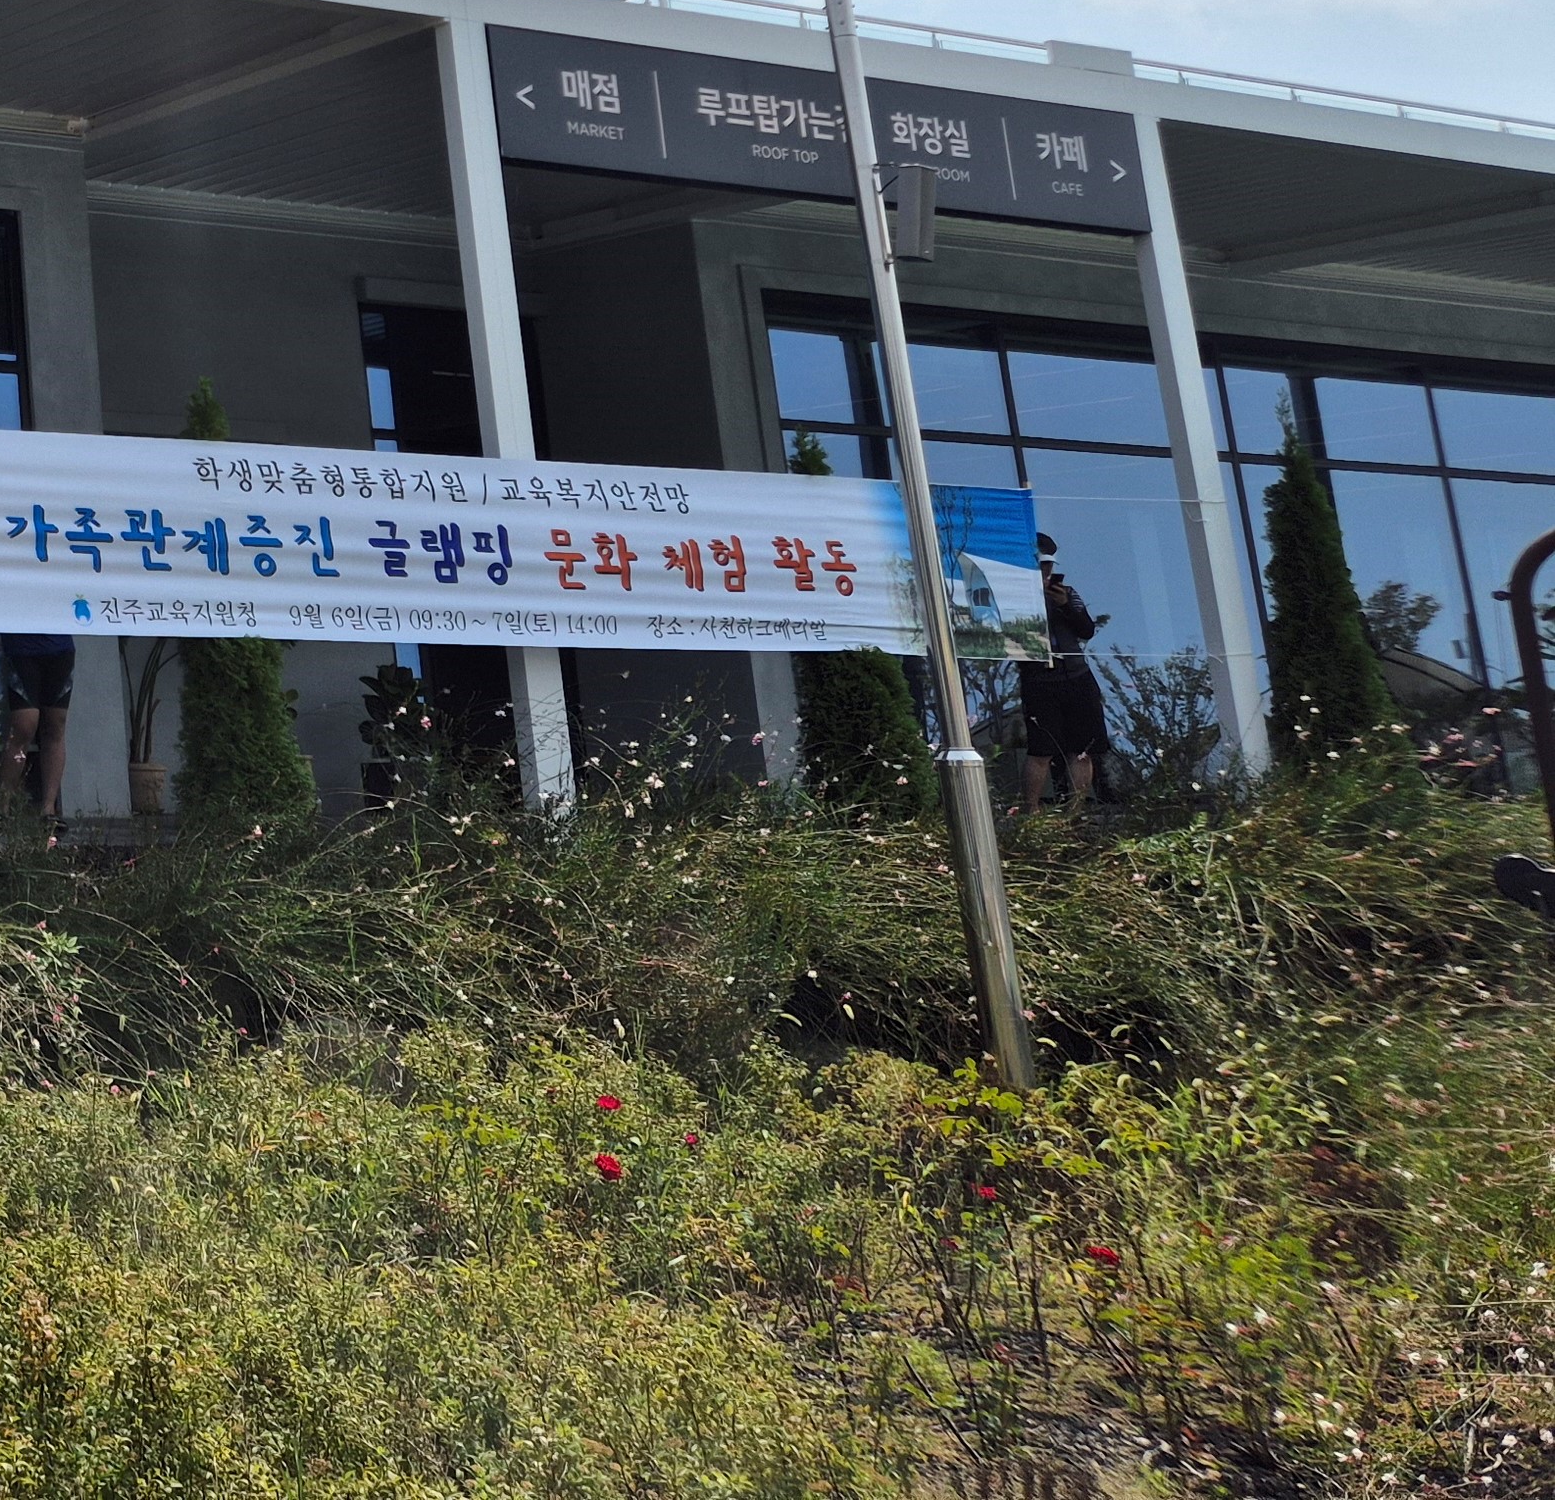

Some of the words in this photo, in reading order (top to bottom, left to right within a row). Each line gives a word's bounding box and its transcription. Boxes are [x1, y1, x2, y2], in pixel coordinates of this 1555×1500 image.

[560, 69, 621, 115] 매점
[566, 121, 625, 141] MARKET
[890, 112, 972, 159] 화장실
[752, 143, 790, 160] ROOF
[791, 149, 819, 164] TOP
[1036, 132, 1089, 173] 카페
[1051, 181, 1084, 197] CAFE
[193, 456, 469, 504] 학생맞춤형통합지원
[499, 476, 691, 514] 교육복지안전망
[6, 504, 341, 579] 가족관계증진
[369, 519, 513, 586] 글램핑
[545, 528, 639, 592] 문화
[664, 534, 746, 593] 체험
[774, 536, 858, 597] 활동
[100, 597, 257, 628] 진주교육지원청
[289, 604, 325, 629] 9월
[331, 604, 401, 632] 6일(금)
[409, 609, 467, 632] 09:30
[492, 610, 558, 637] 7일(토)
[567, 614, 618, 636] 14:00
